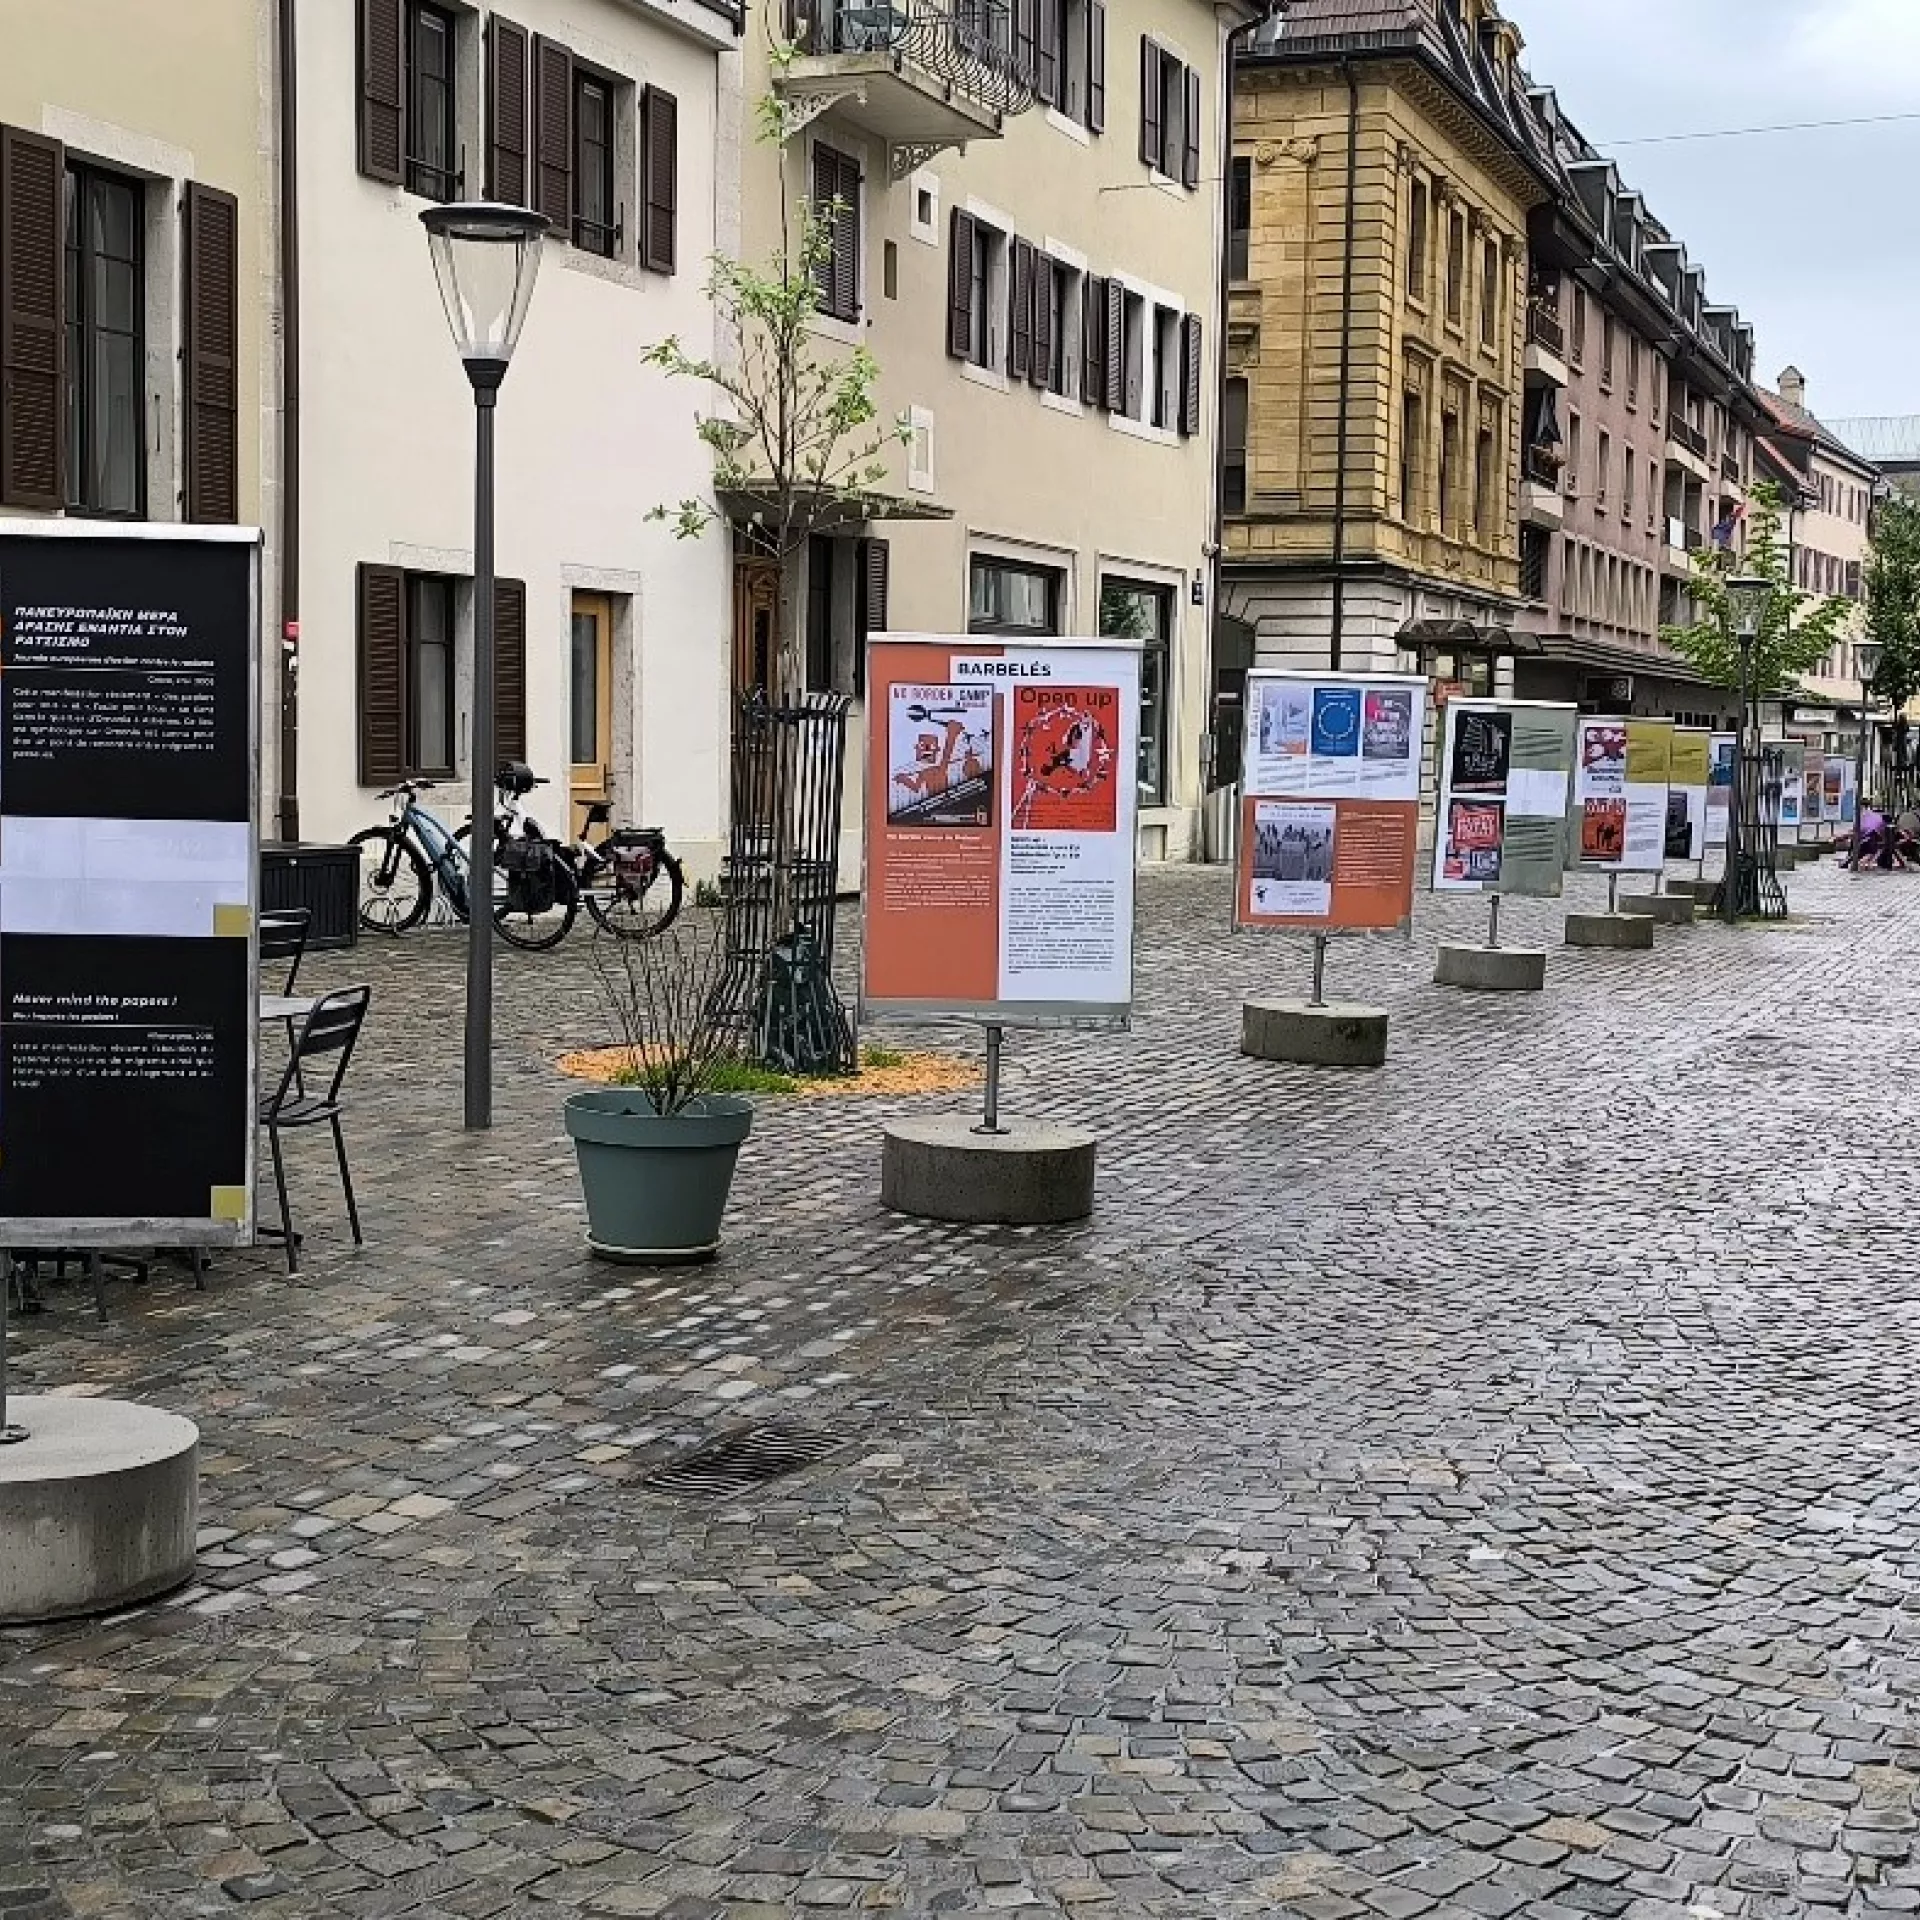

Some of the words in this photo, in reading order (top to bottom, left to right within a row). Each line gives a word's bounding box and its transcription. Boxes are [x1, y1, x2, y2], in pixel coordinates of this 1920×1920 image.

[957, 660, 1051, 677] BARBELÉS
[1020, 688, 1078, 708] Open
[1086, 691, 1112, 709] up
[13, 993, 53, 1004] Never
[56, 992, 92, 1006] mind
[95, 994, 119, 1006] the
[120, 996, 169, 1008] papers
